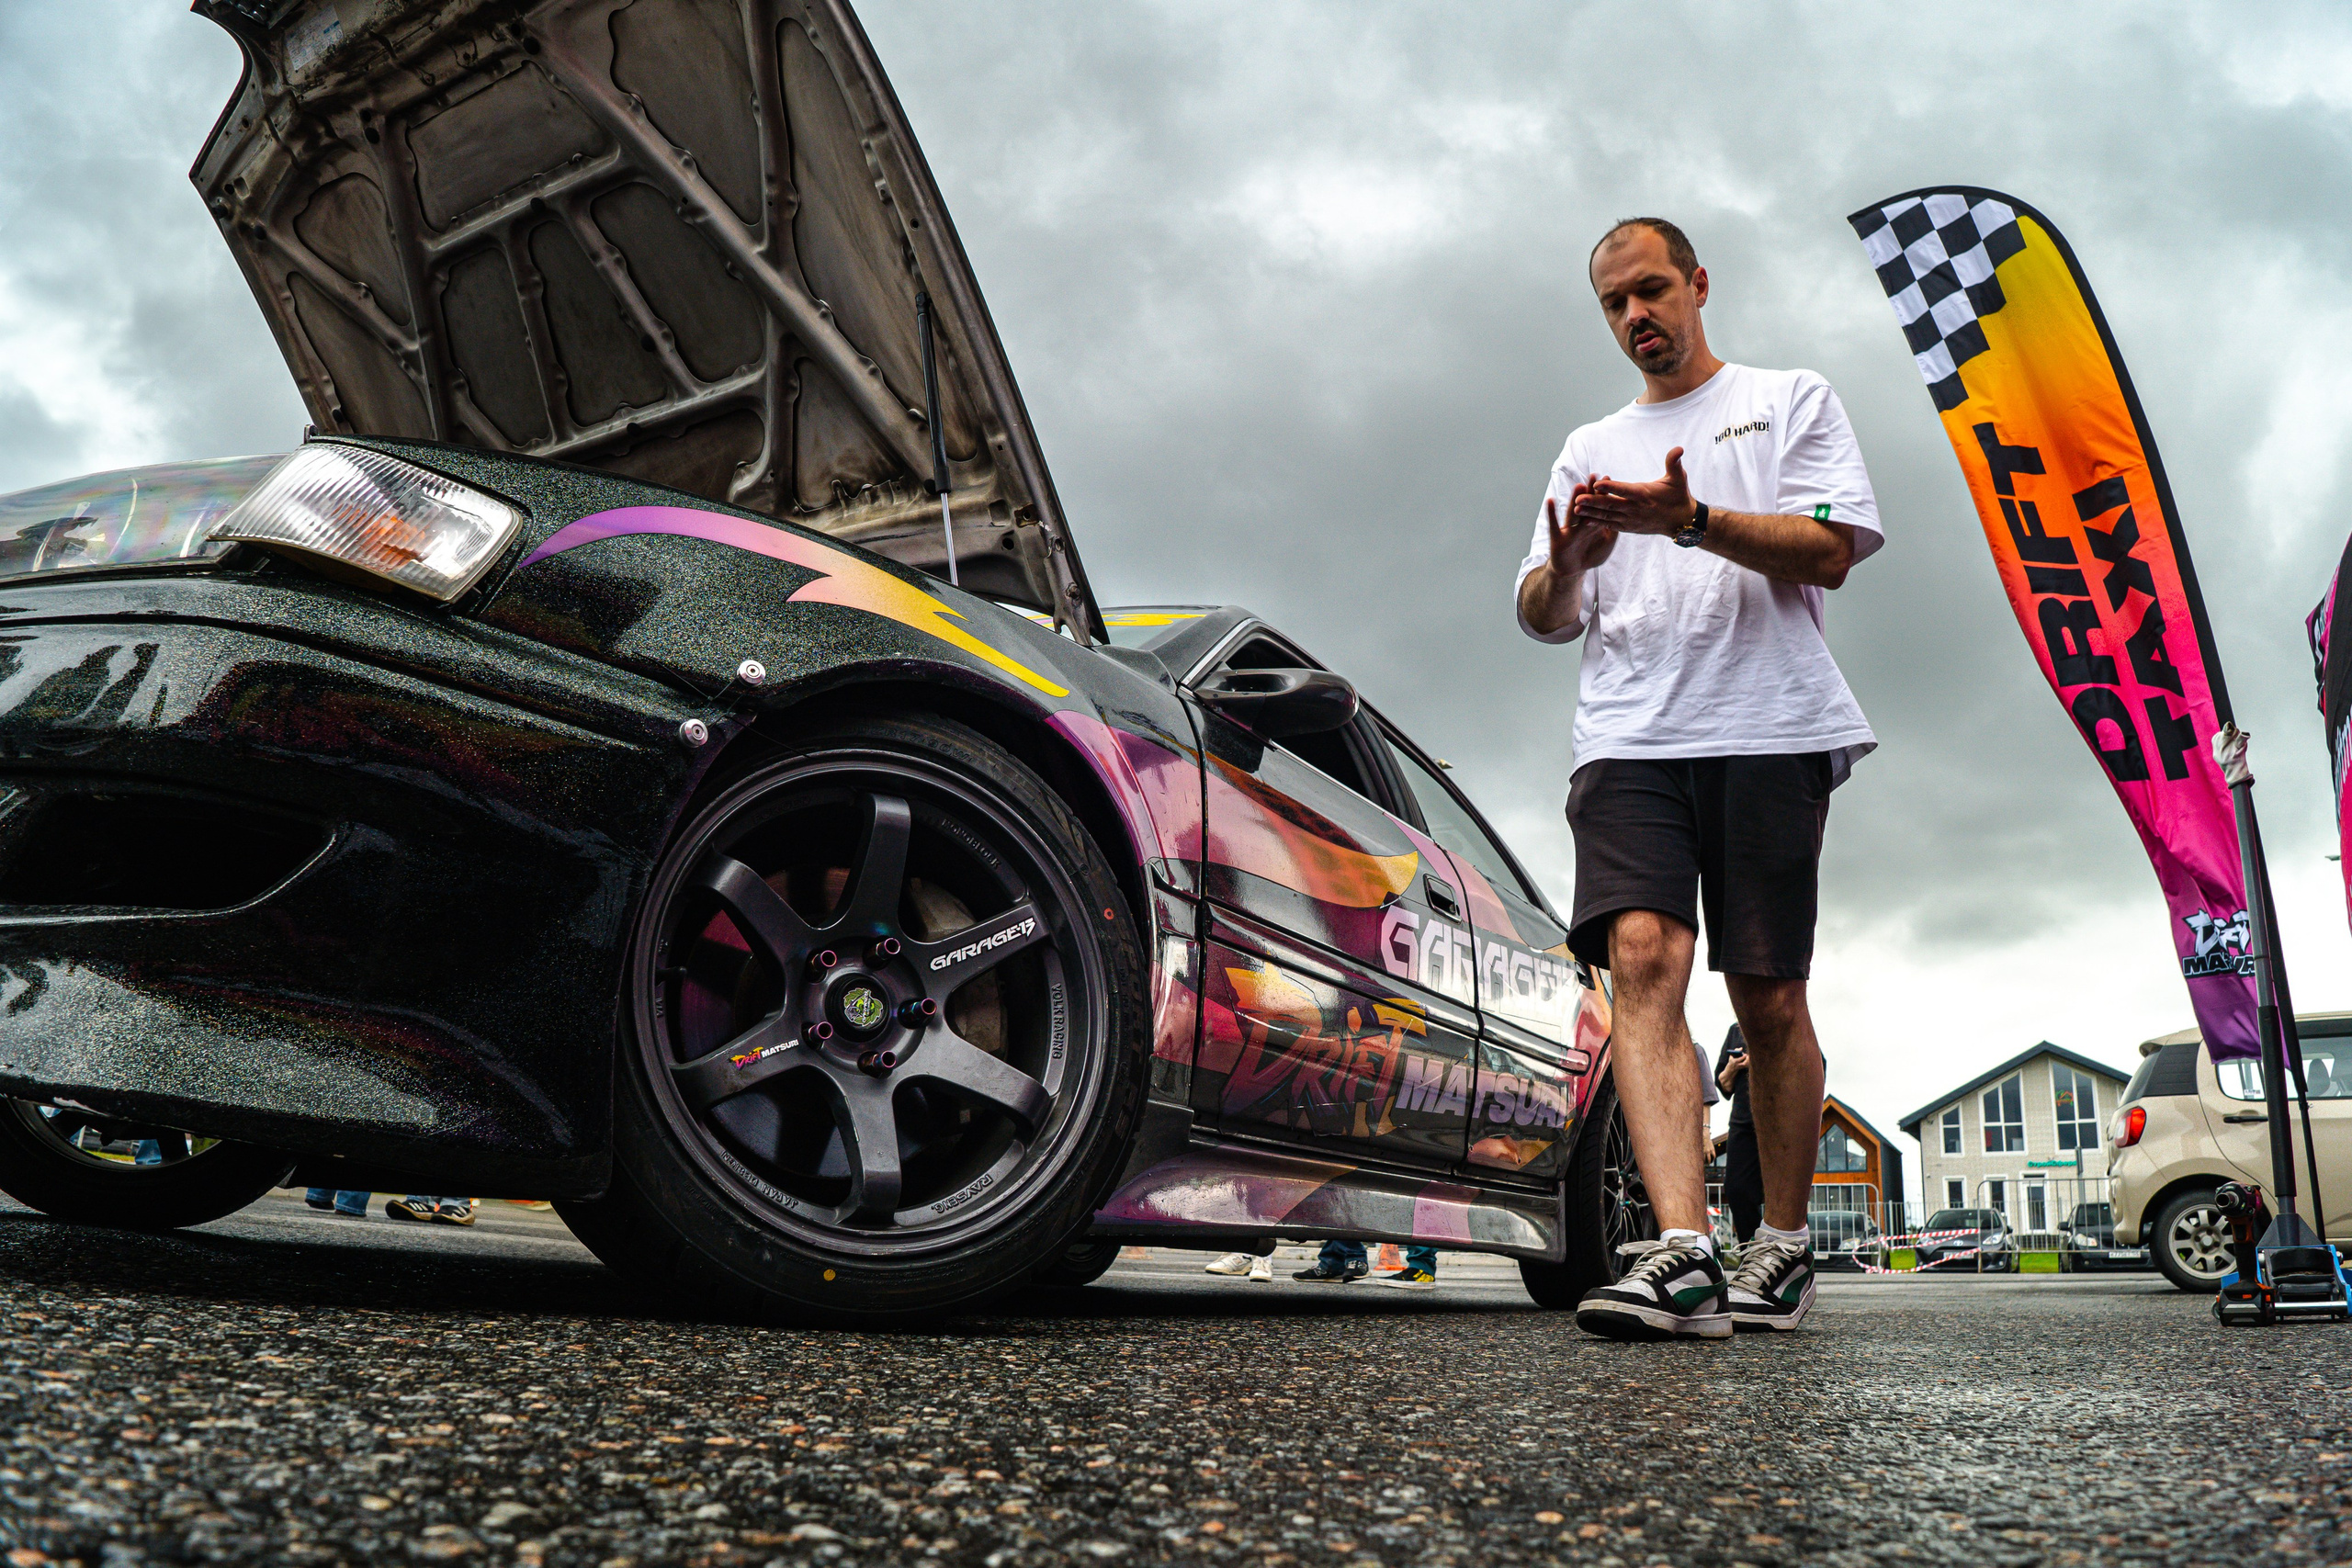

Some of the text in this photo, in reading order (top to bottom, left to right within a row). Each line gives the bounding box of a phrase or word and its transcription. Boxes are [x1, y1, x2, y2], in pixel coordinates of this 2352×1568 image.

[1734, 422, 1770, 436] HARD!
[1972, 422, 2151, 782] DRIFT
[2072, 475, 2199, 782] TAXI
[1051, 983, 1065, 1060] VOLK RACING
[761, 1039, 799, 1058] MATSURI
[761, 1183, 798, 1209] JAPAN
